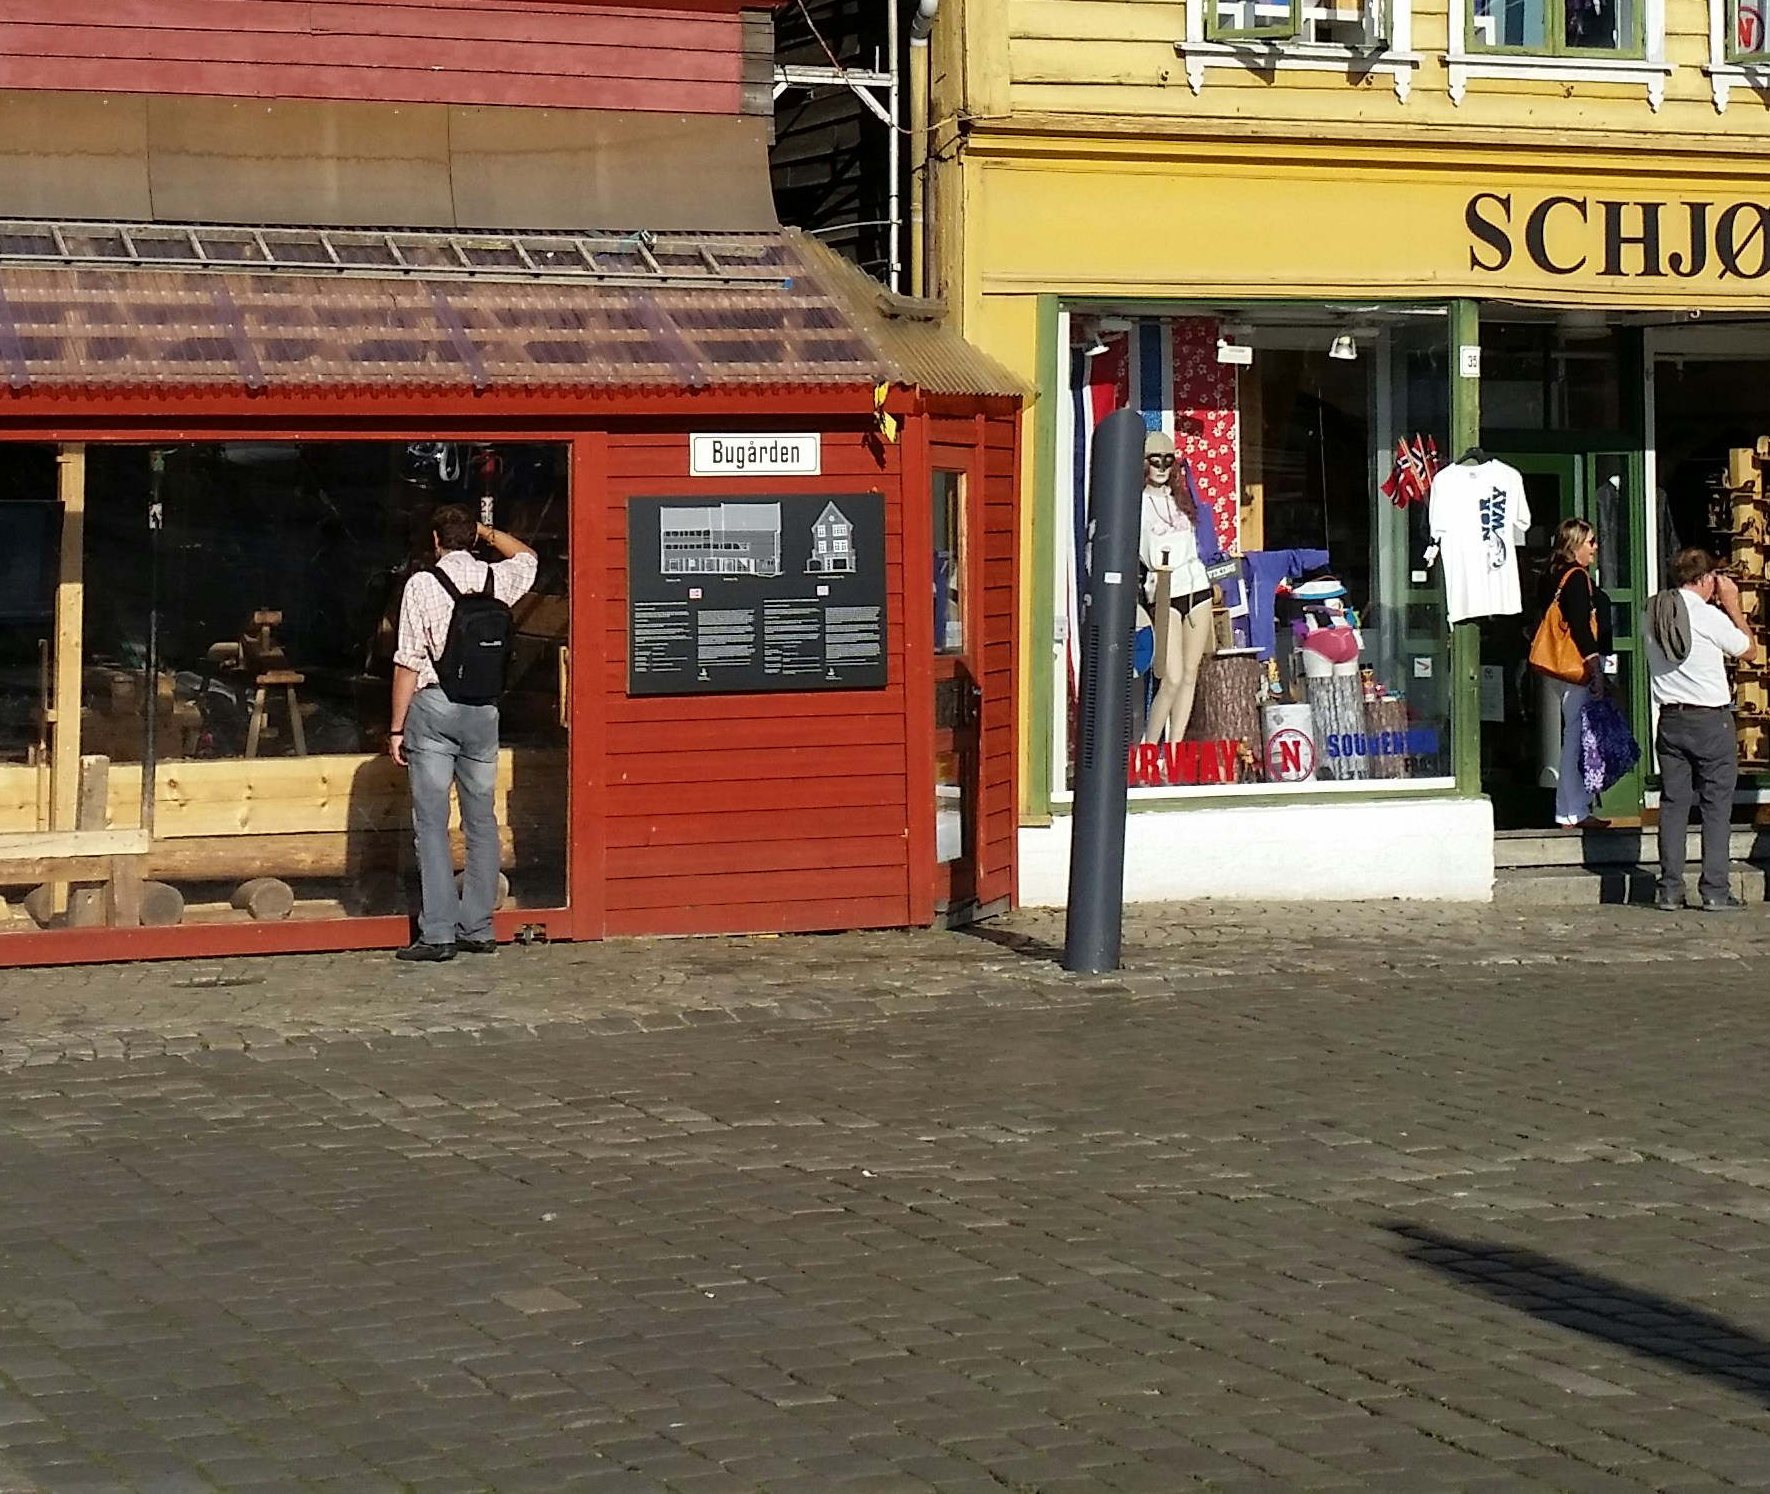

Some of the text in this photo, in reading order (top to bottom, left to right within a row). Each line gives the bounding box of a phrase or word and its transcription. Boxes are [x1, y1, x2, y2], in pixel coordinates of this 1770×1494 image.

[712, 439, 801, 469] Bugården
[1491, 486, 1507, 533] WAY
[1126, 739, 1239, 786] RWAY
[1327, 729, 1438, 758] SOUEN
